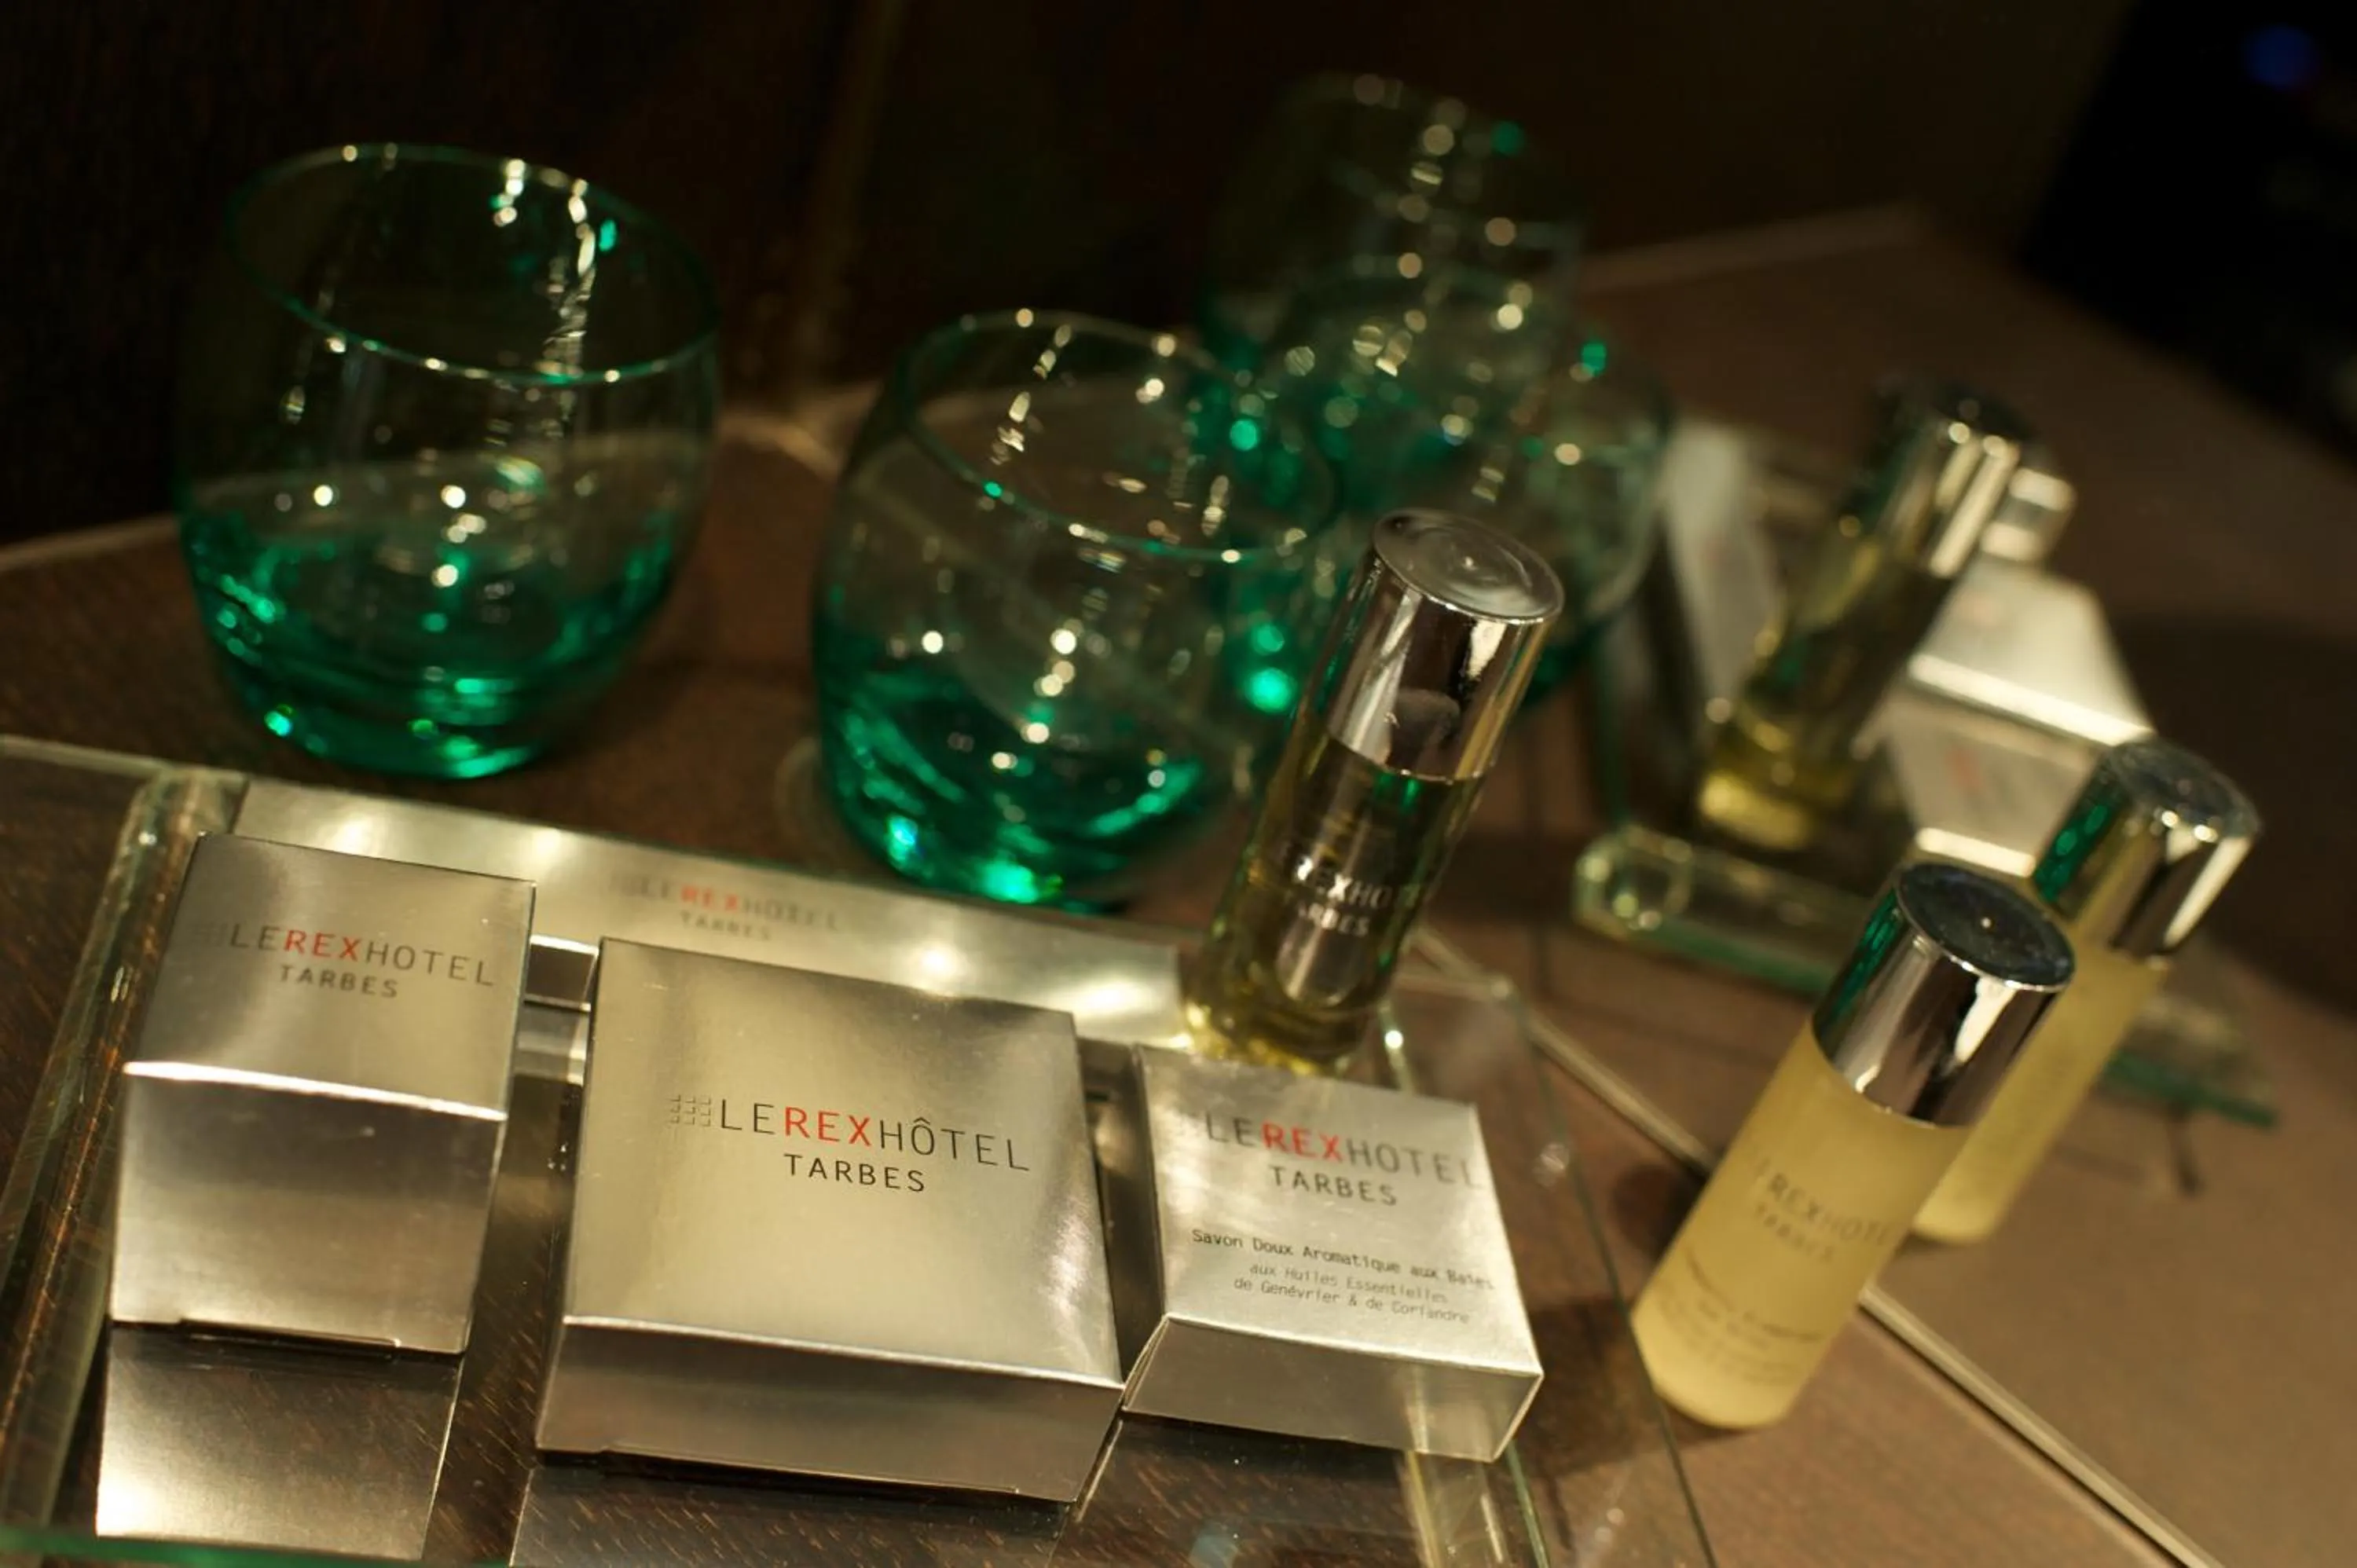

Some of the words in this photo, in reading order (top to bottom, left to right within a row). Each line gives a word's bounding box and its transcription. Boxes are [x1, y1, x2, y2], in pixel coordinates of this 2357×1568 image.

[280, 964, 398, 1006] TARBES
[784, 1152, 926, 1192] TARBES
[1269, 1165, 1397, 1207] TARBES
[1192, 1228, 1244, 1249] Savon
[1252, 1236, 1295, 1256] Doux
[1302, 1245, 1402, 1275] Aromatique
[1410, 1266, 1438, 1280] aux
[1233, 1277, 1253, 1291] de
[1260, 1280, 1340, 1304] Genévrier
[1365, 1297, 1384, 1311] de
[1249, 1262, 1277, 1277] aux
[1285, 1266, 1338, 1288] Huiles
